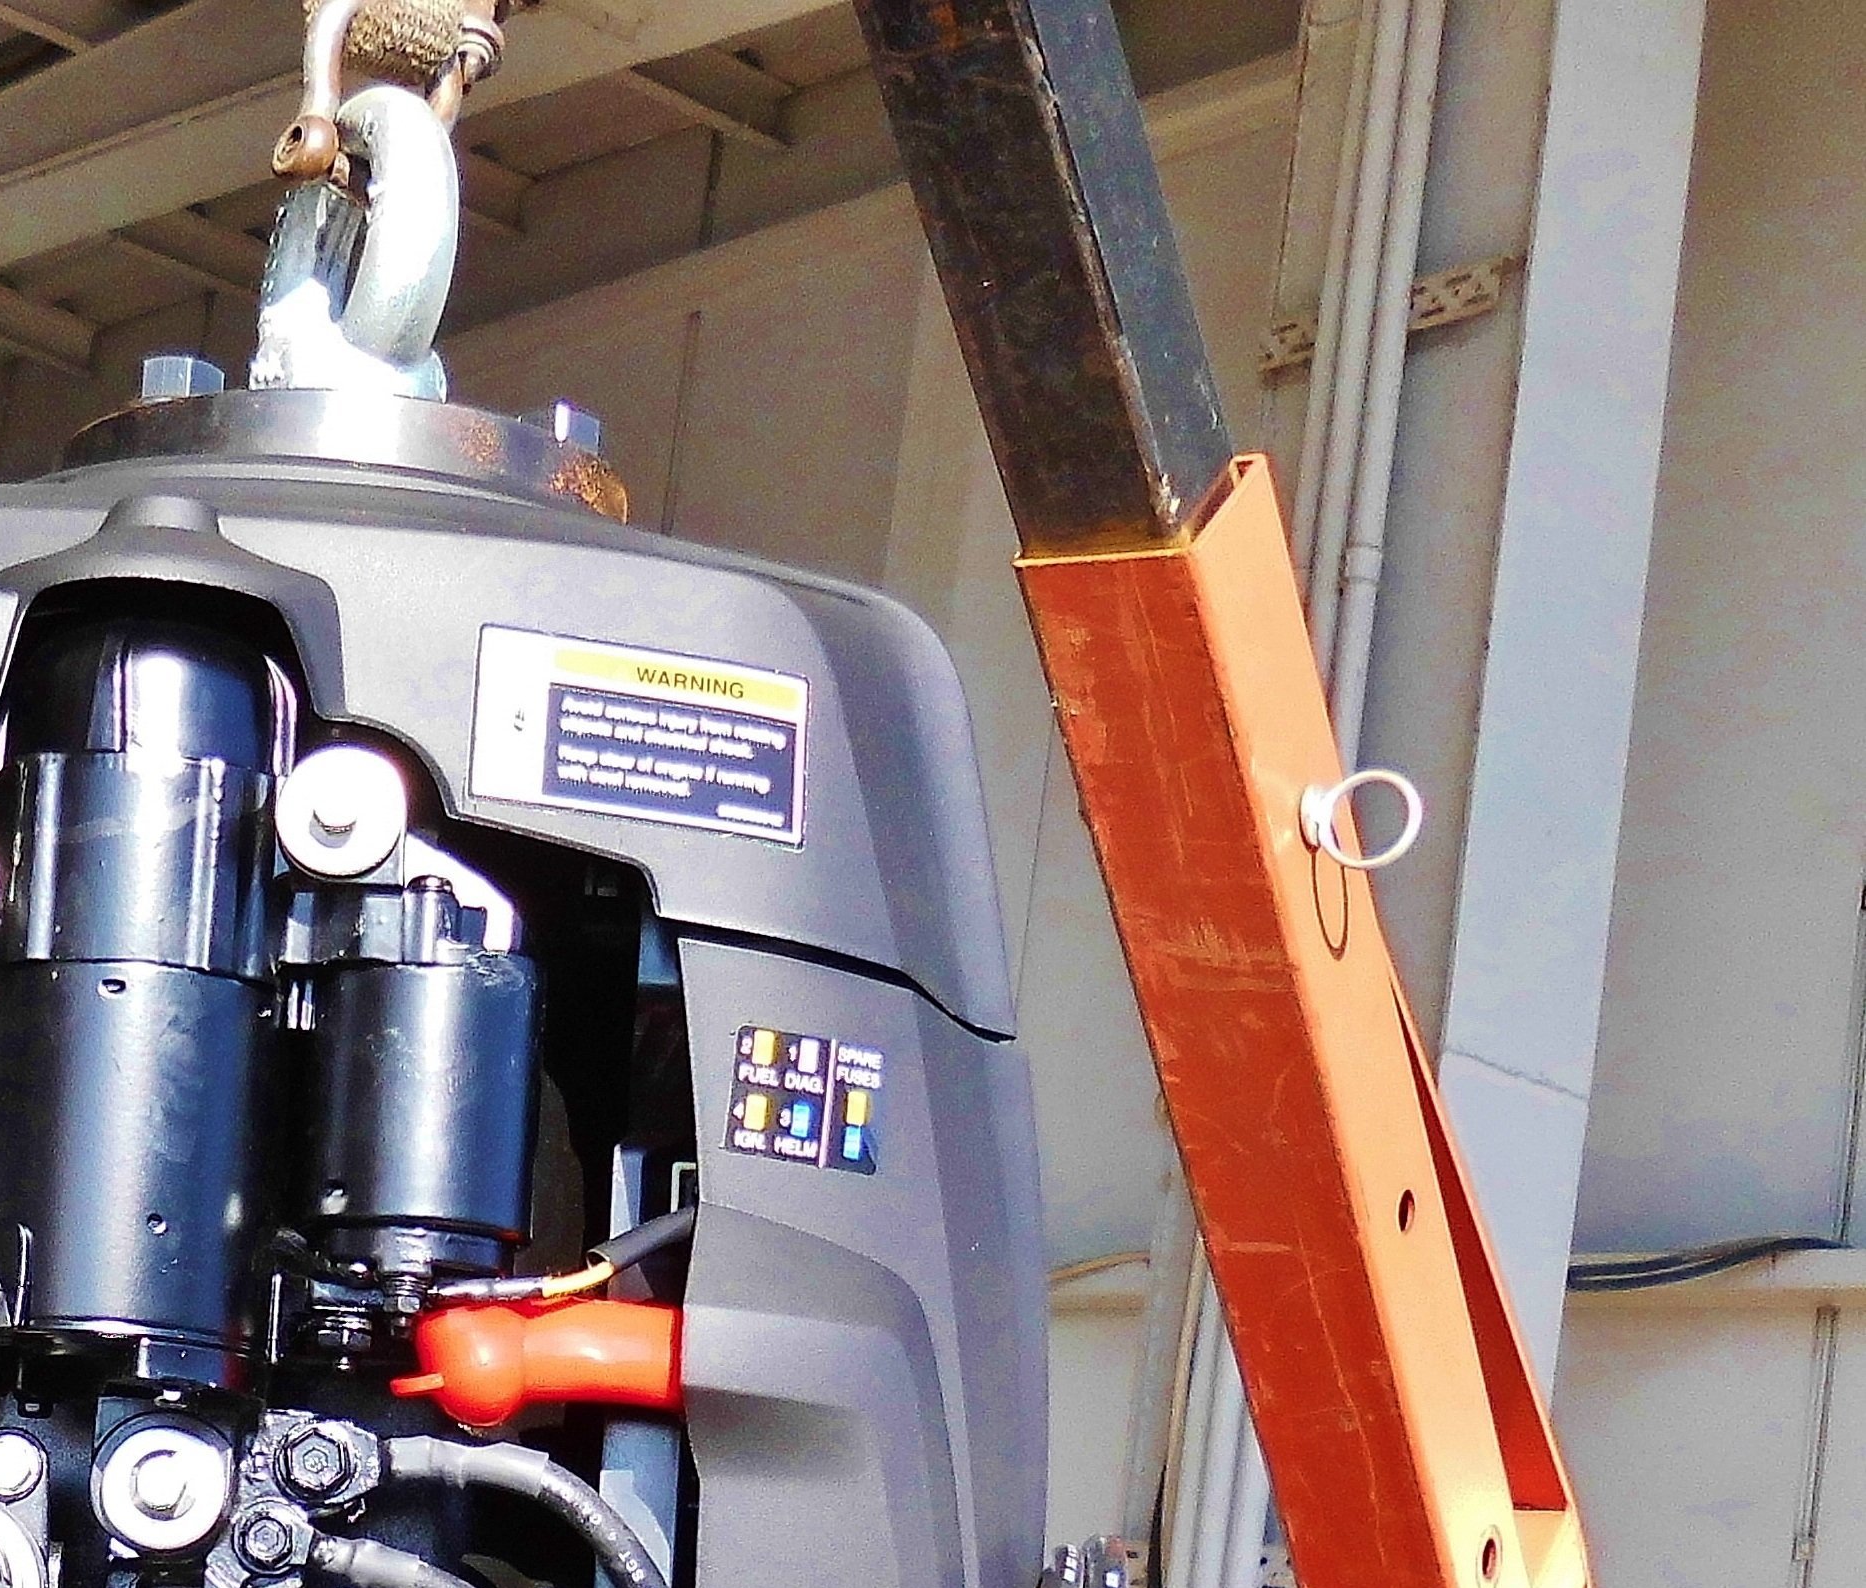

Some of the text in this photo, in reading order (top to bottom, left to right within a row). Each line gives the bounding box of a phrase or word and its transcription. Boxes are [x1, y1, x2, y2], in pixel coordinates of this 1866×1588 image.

[636, 666, 745, 700] WARNING
[739, 1035, 753, 1055] 2
[837, 1046, 884, 1070] SPARE
[737, 1064, 779, 1087] FUEL
[783, 1071, 825, 1095] DIAG.
[836, 1066, 882, 1088] FUSES
[773, 1135, 818, 1158] HELM
